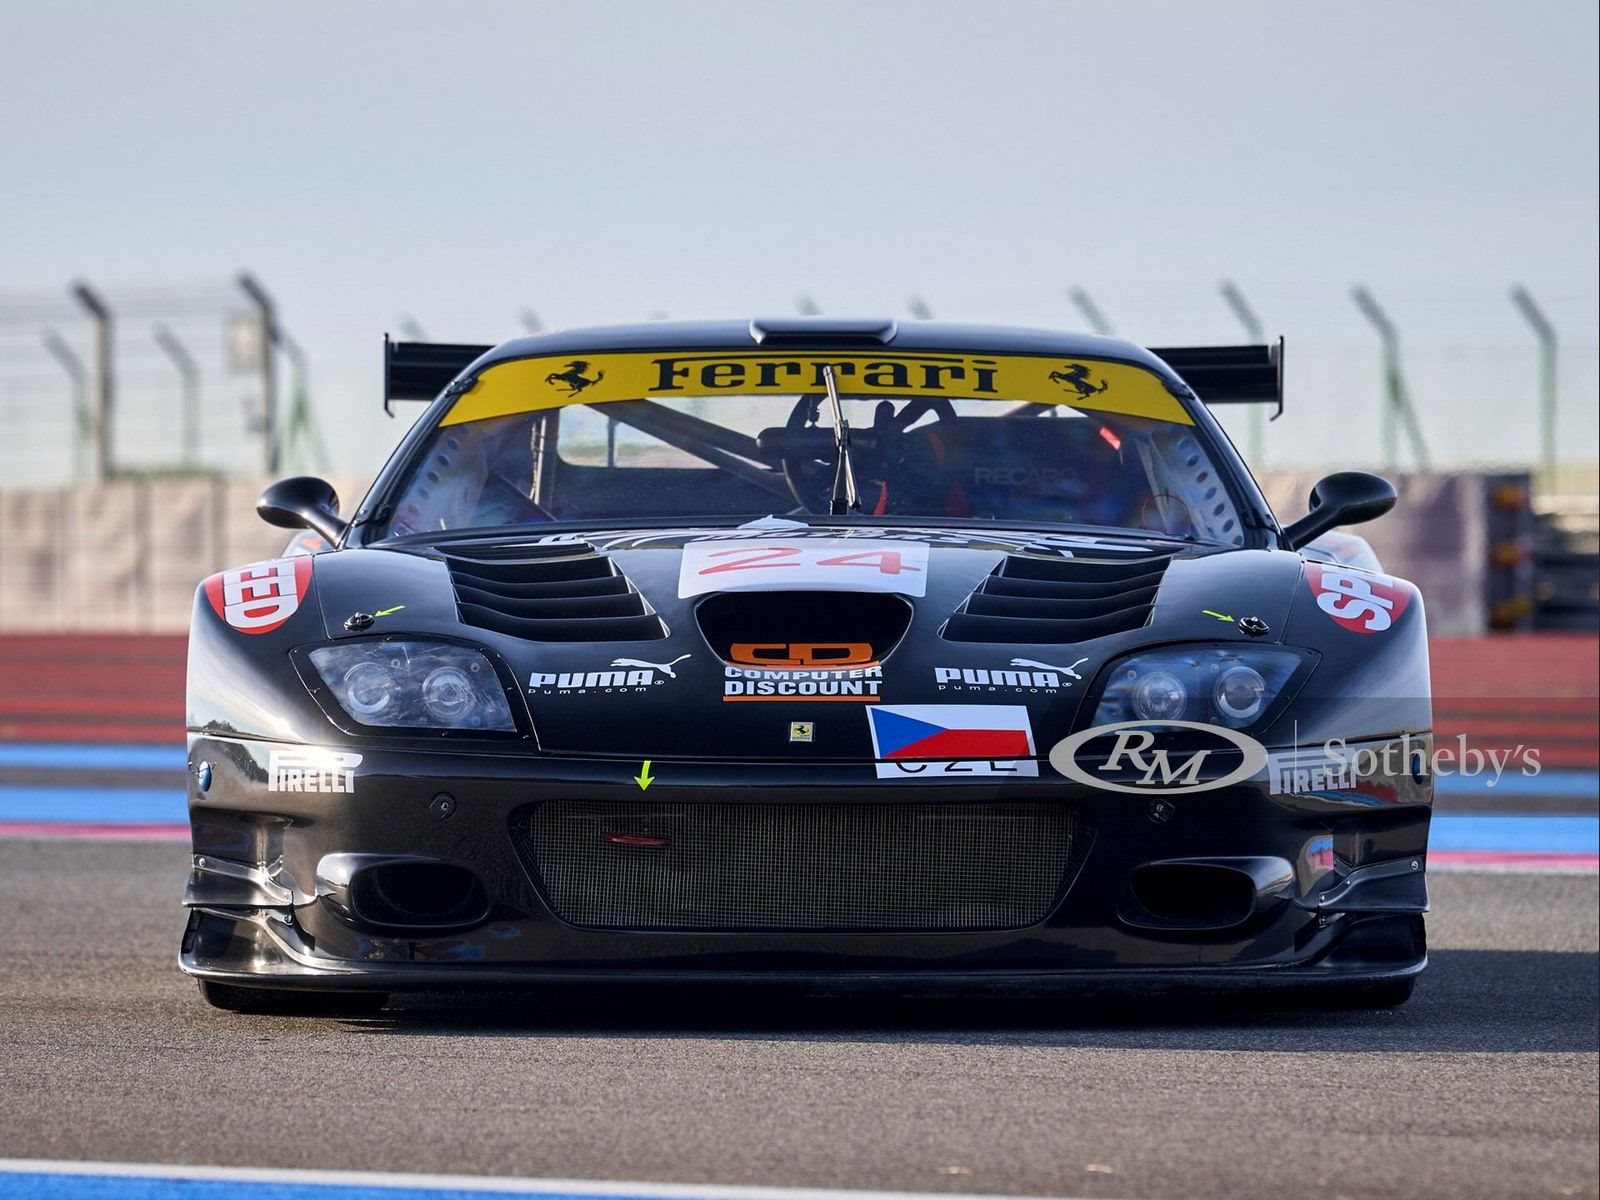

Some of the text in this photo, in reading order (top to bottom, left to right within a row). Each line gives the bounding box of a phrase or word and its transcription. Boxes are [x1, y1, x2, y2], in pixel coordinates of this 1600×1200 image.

[648, 353, 998, 393] Ferrari
[699, 545, 921, 576] 24
[529, 670, 654, 688] PUMA
[724, 665, 883, 680] COMPUTER
[934, 667, 1060, 687] PUMA
[528, 687, 647, 695] puma.com
[724, 680, 883, 695] DISCOUNT
[938, 685, 1058, 694] puma.com
[267, 750, 363, 793] PIRELLI
[1264, 747, 1357, 795] PIRELLI
